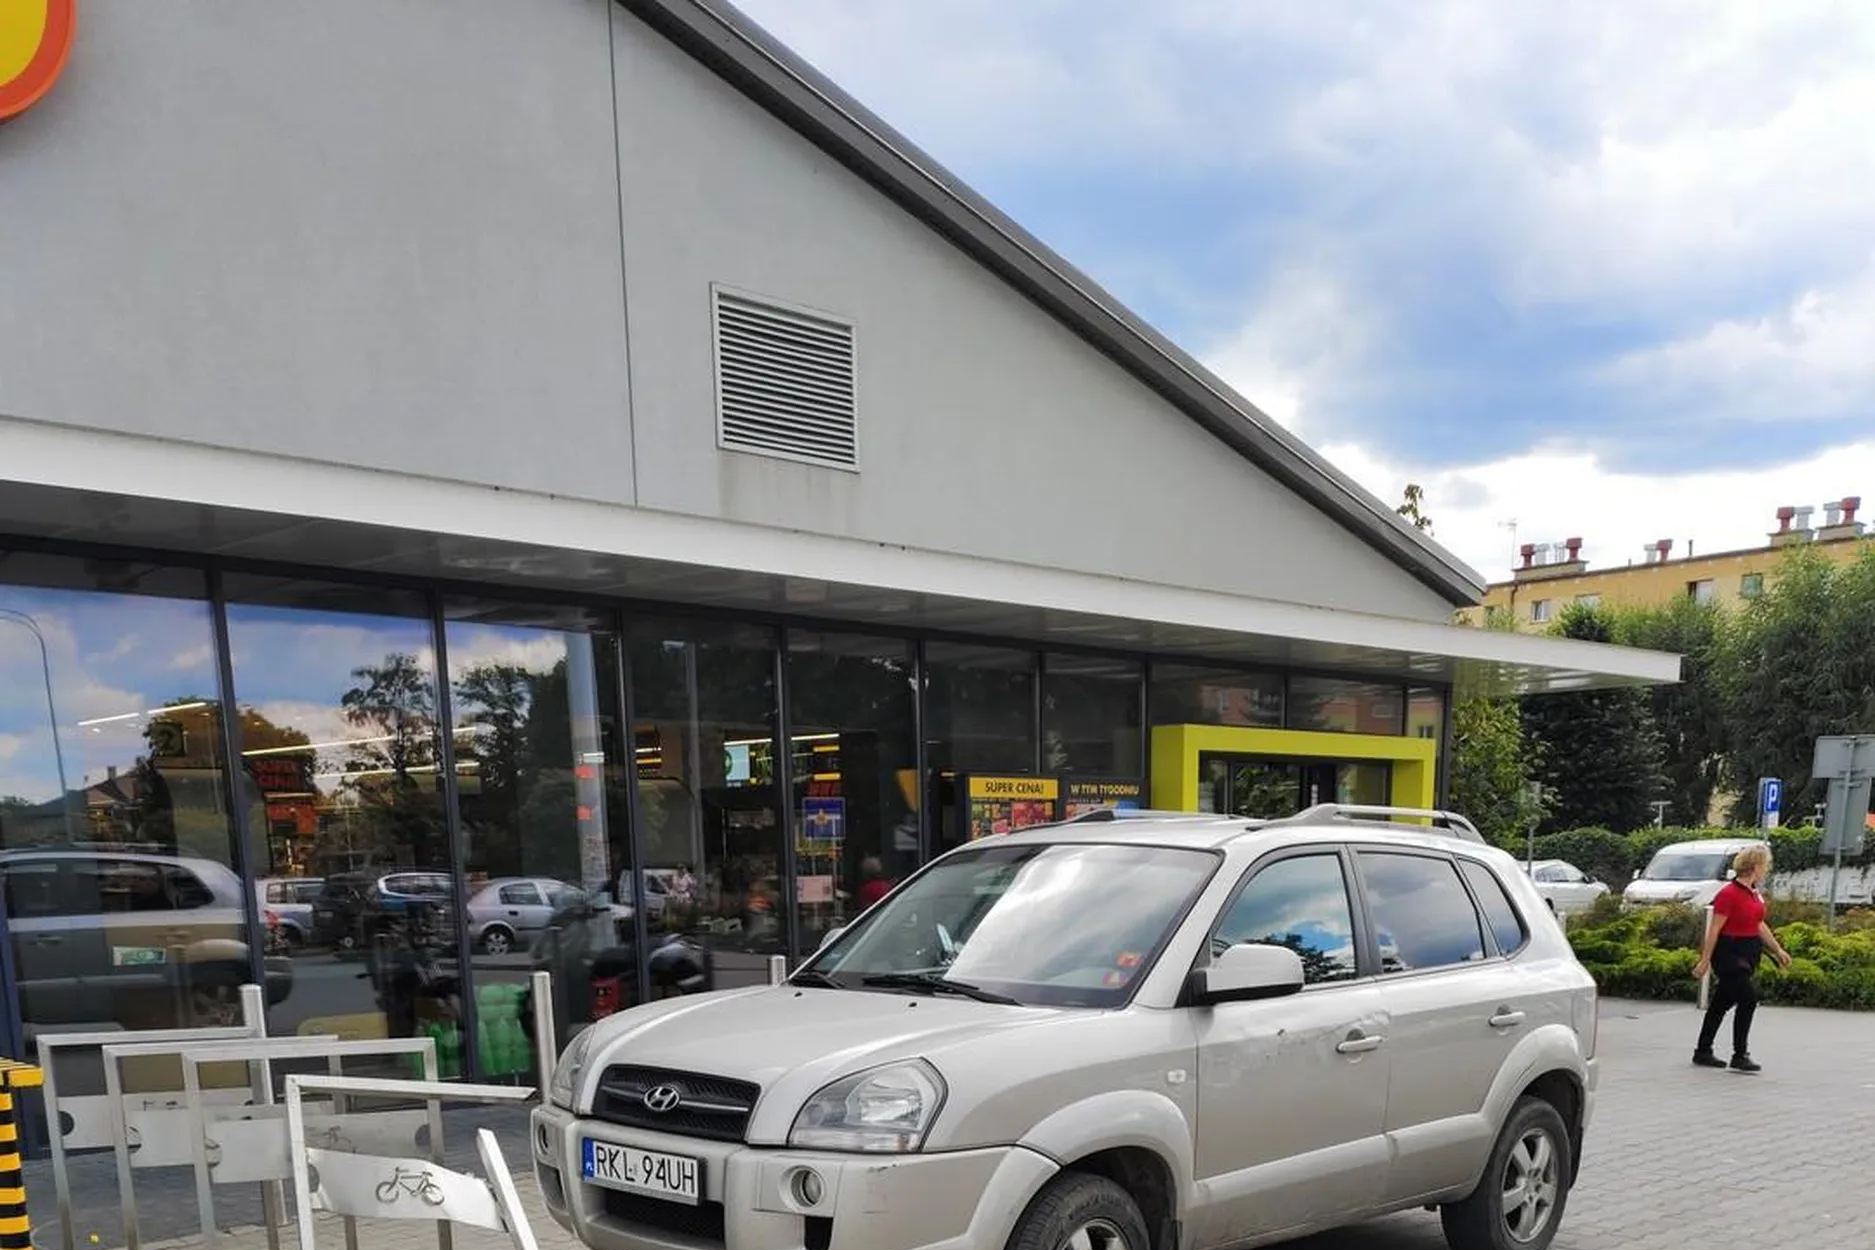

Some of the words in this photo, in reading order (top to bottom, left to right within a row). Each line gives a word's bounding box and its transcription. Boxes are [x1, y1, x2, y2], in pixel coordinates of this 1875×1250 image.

[985, 781, 1013, 793] SUPER
[1015, 782, 1044, 794] CENA!
[1070, 783, 1081, 794] W
[1081, 783, 1098, 795] TYM
[1099, 783, 1140, 796] TYGODNIU
[1768, 784, 1778, 810] P
[596, 1145, 635, 1182] RKL
[642, 1155, 695, 1194] 94UH
